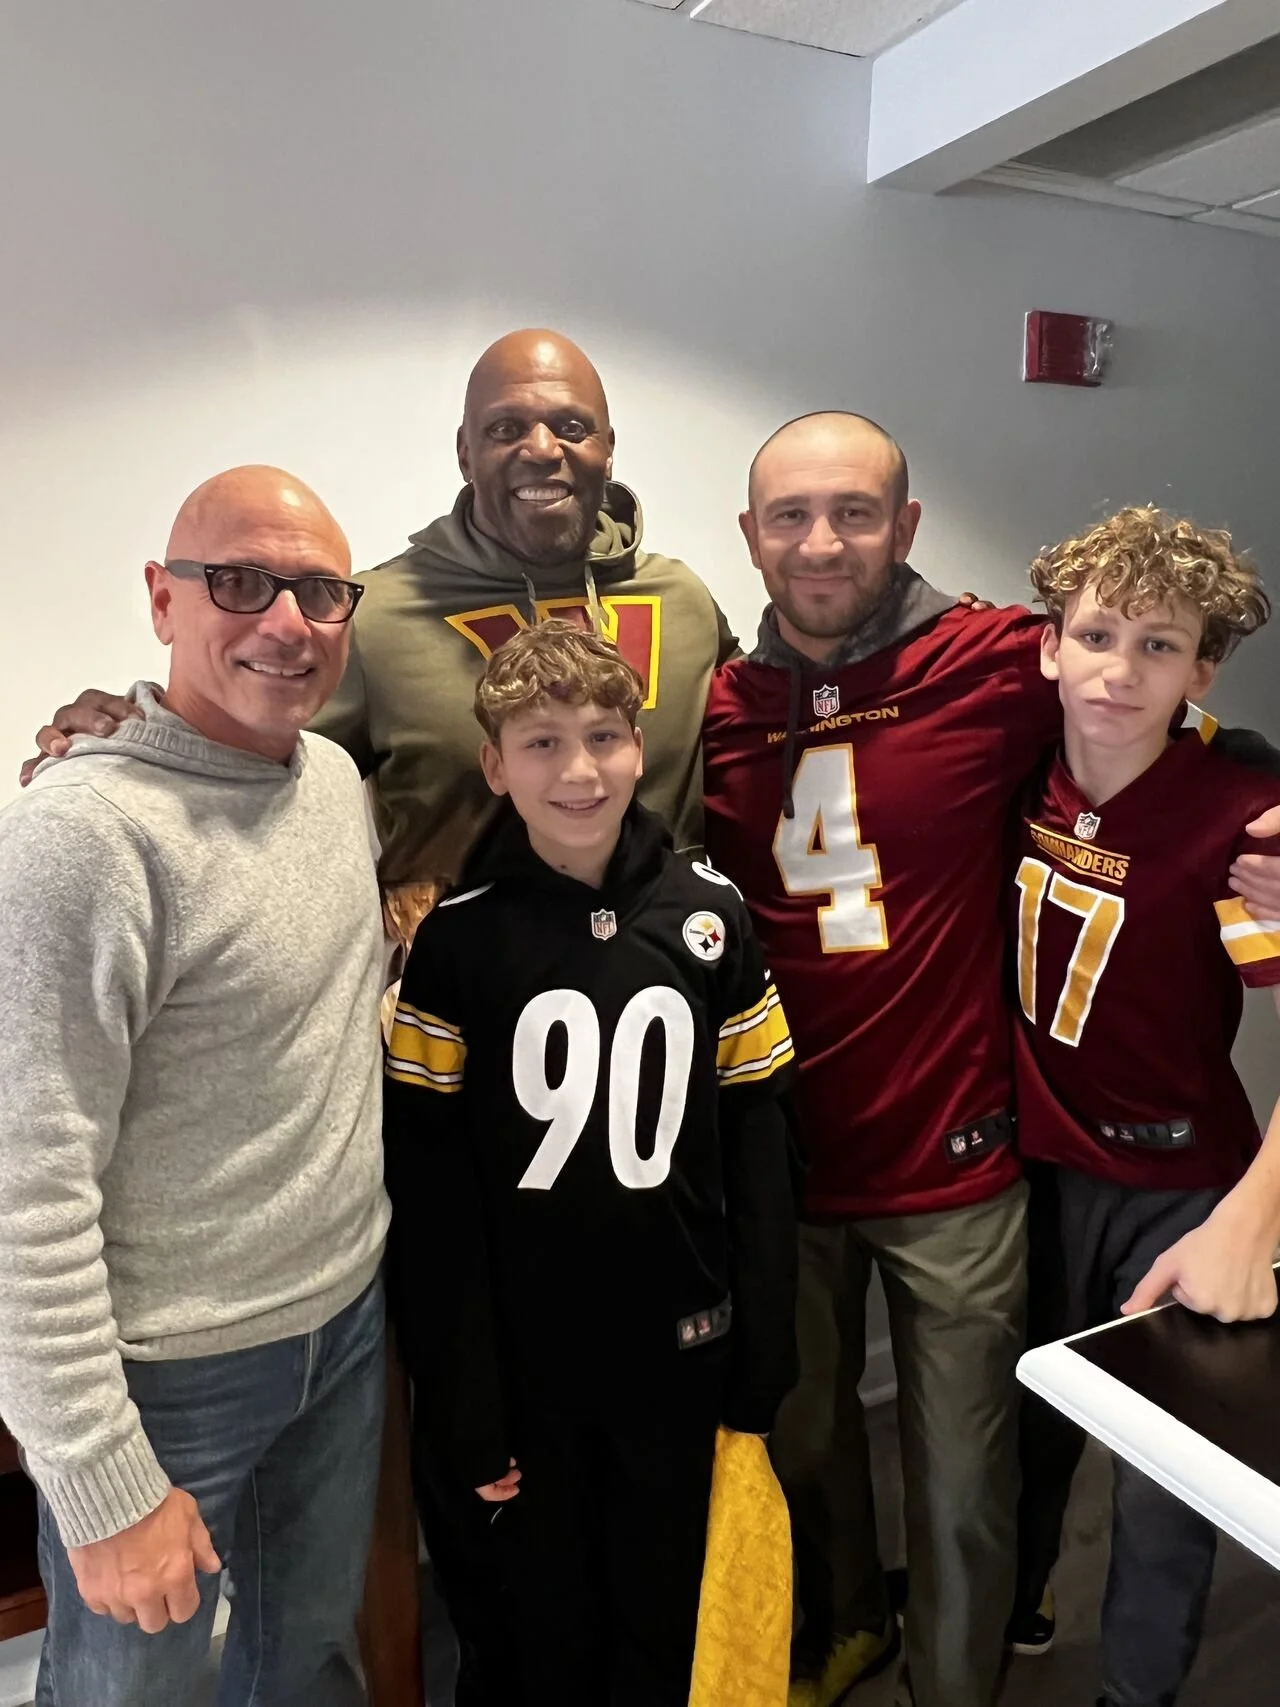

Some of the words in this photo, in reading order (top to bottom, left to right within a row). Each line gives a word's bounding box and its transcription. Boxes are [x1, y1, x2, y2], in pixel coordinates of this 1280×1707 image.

[767, 705, 900, 744] WINGTON
[816, 698, 836, 713] NFL
[772, 742, 889, 954] 4
[595, 922, 612, 935] NFL
[1014, 856, 1125, 1048] 17
[512, 985, 695, 1190] 90
